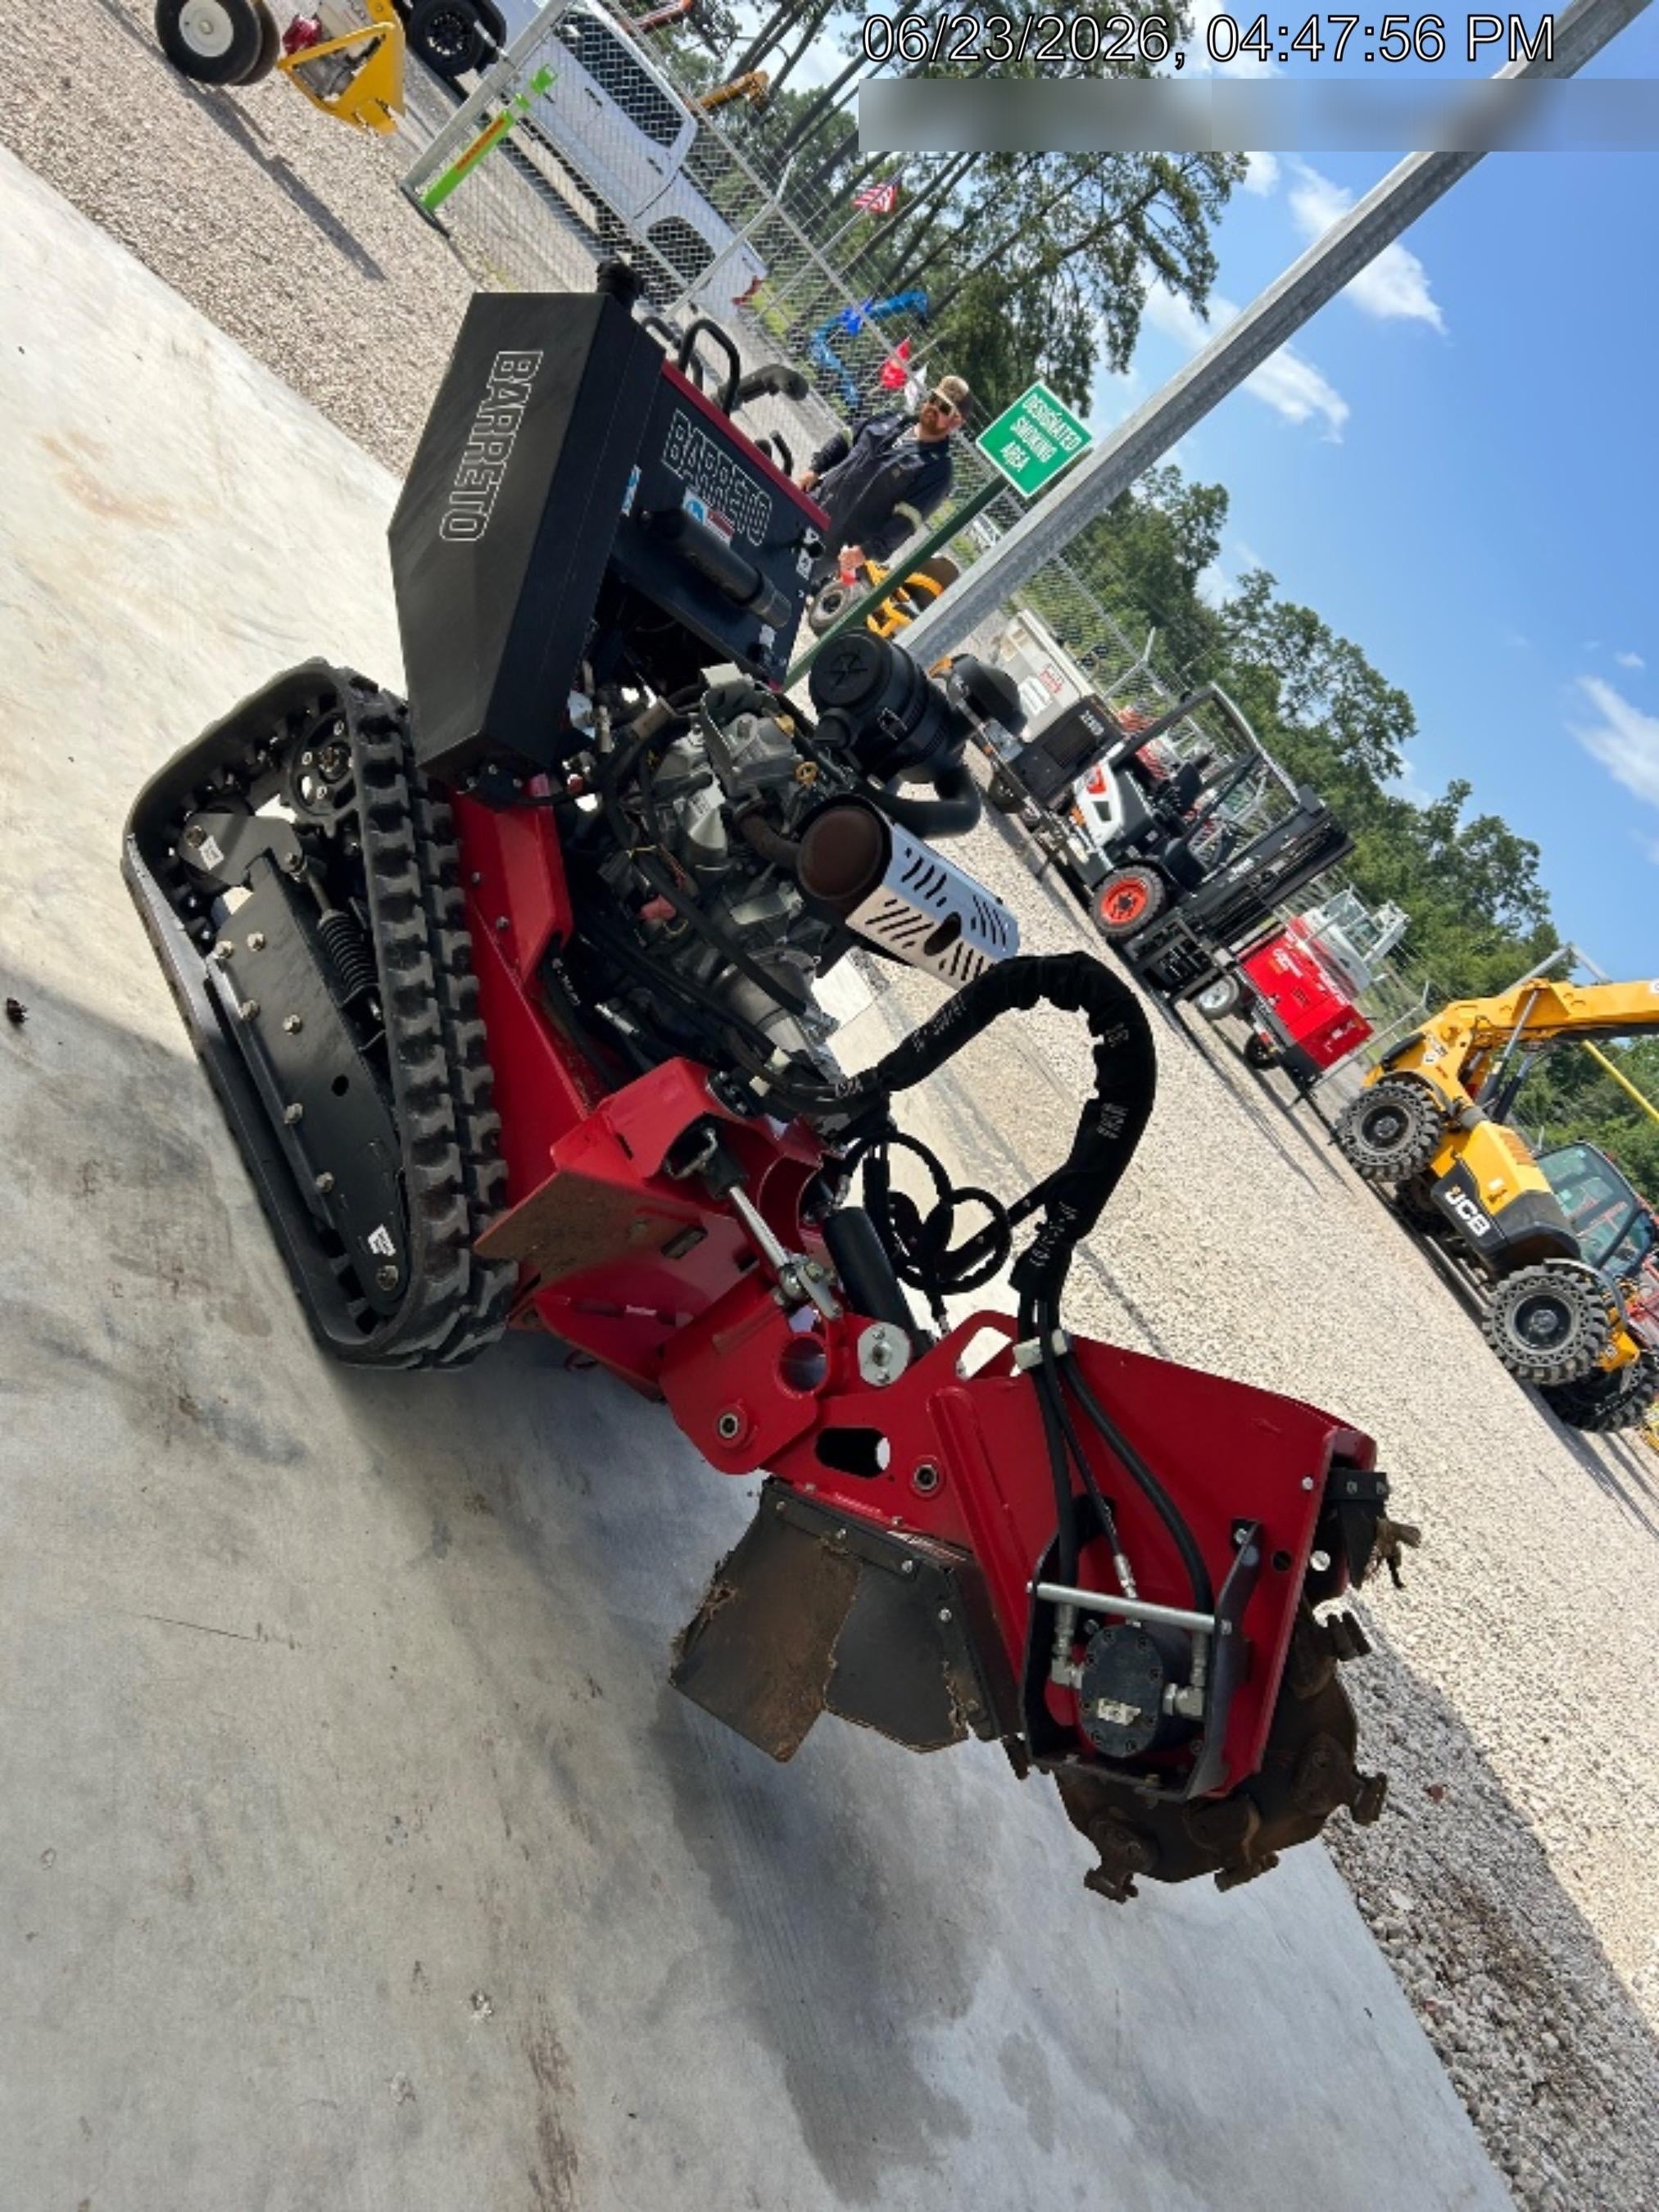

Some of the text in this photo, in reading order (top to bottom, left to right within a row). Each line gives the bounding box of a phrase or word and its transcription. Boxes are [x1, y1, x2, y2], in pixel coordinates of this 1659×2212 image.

[439, 350, 544, 542] BARRETO
[1022, 393, 1082, 452] DESIGNATED
[660, 408, 773, 546] BARRETO
[1444, 1185, 1491, 1237] JCB
